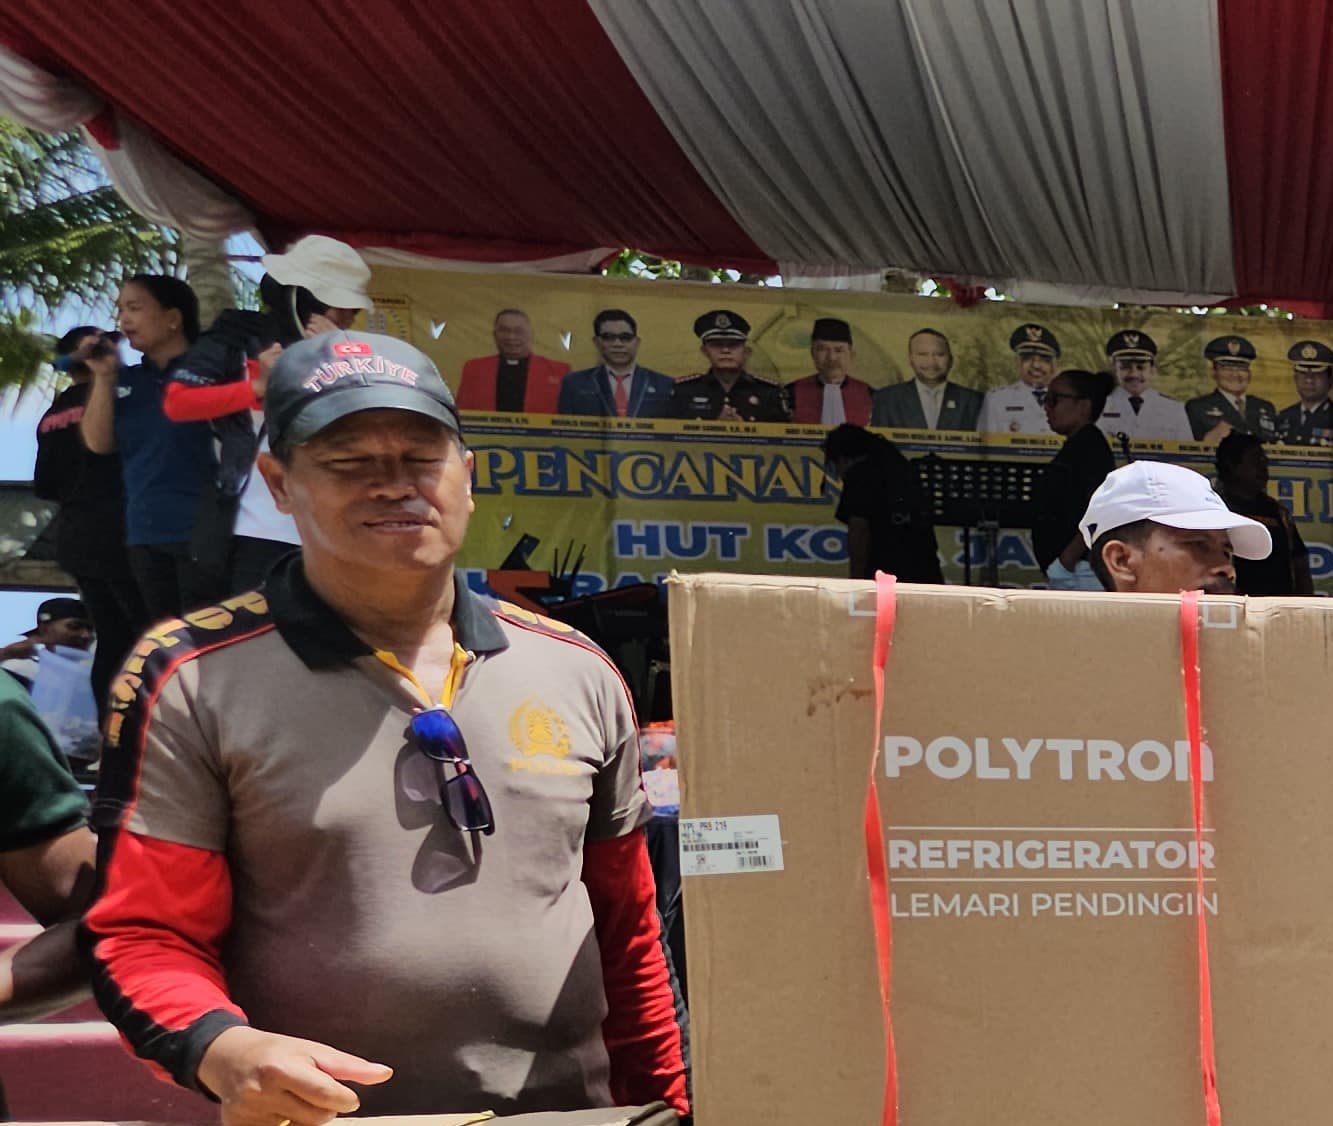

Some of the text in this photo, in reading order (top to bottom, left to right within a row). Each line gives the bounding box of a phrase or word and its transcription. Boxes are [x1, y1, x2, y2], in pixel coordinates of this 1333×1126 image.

[471, 445, 846, 504] PENCANAN
[613, 521, 749, 561] HUT
[765, 526, 851, 562] KO
[888, 839, 1216, 870] REFRIGERATOR
[890, 892, 1219, 918] LEMARI PENDINGIN
